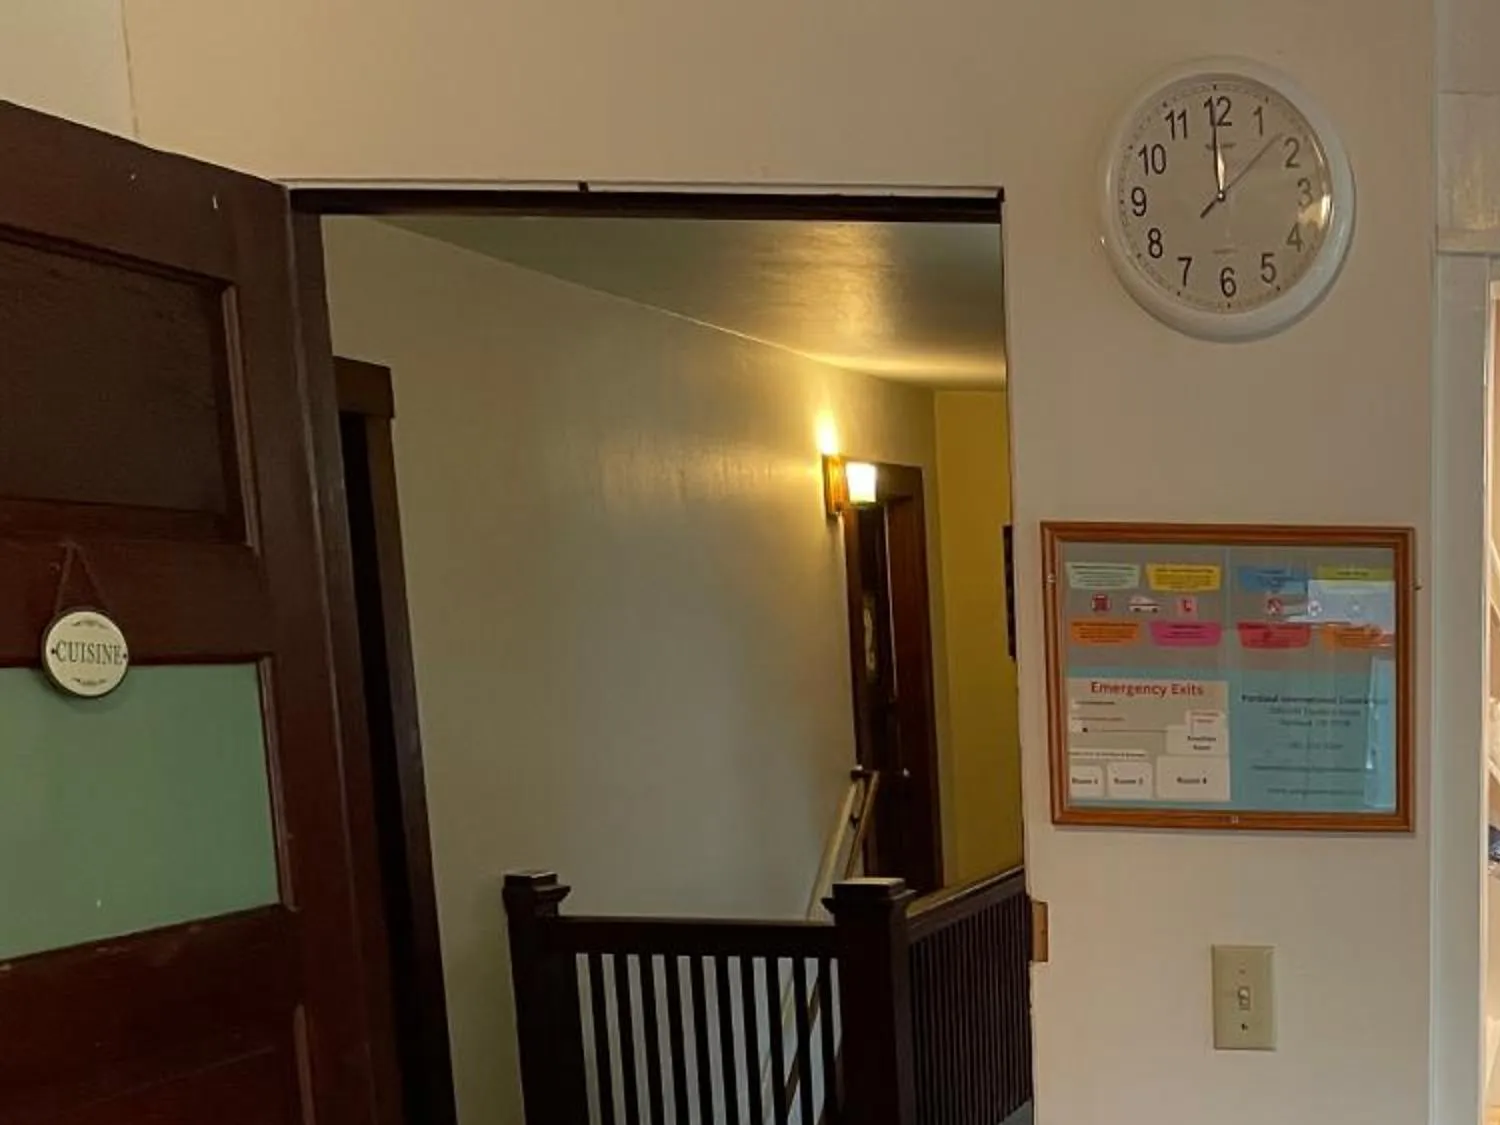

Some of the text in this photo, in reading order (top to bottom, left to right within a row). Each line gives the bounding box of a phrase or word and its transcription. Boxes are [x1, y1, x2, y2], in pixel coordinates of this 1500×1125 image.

[1164, 110, 1187, 139] 11
[1203, 96, 1233, 127] 12
[1253, 106, 1264, 136] 1
[1138, 143, 1167, 176] 10
[1285, 137, 1300, 169] 2
[1131, 187, 1147, 217] 9
[1298, 178, 1313, 207] 3
[1148, 228, 1163, 258] 8
[1287, 222, 1304, 253] 4
[1177, 256, 1192, 286] 7
[1220, 266, 1236, 297] 6
[1260, 253, 1276, 283] 5
[55, 640, 123, 665] CUISINE
[1091, 681, 1204, 697] Emergency Exits
